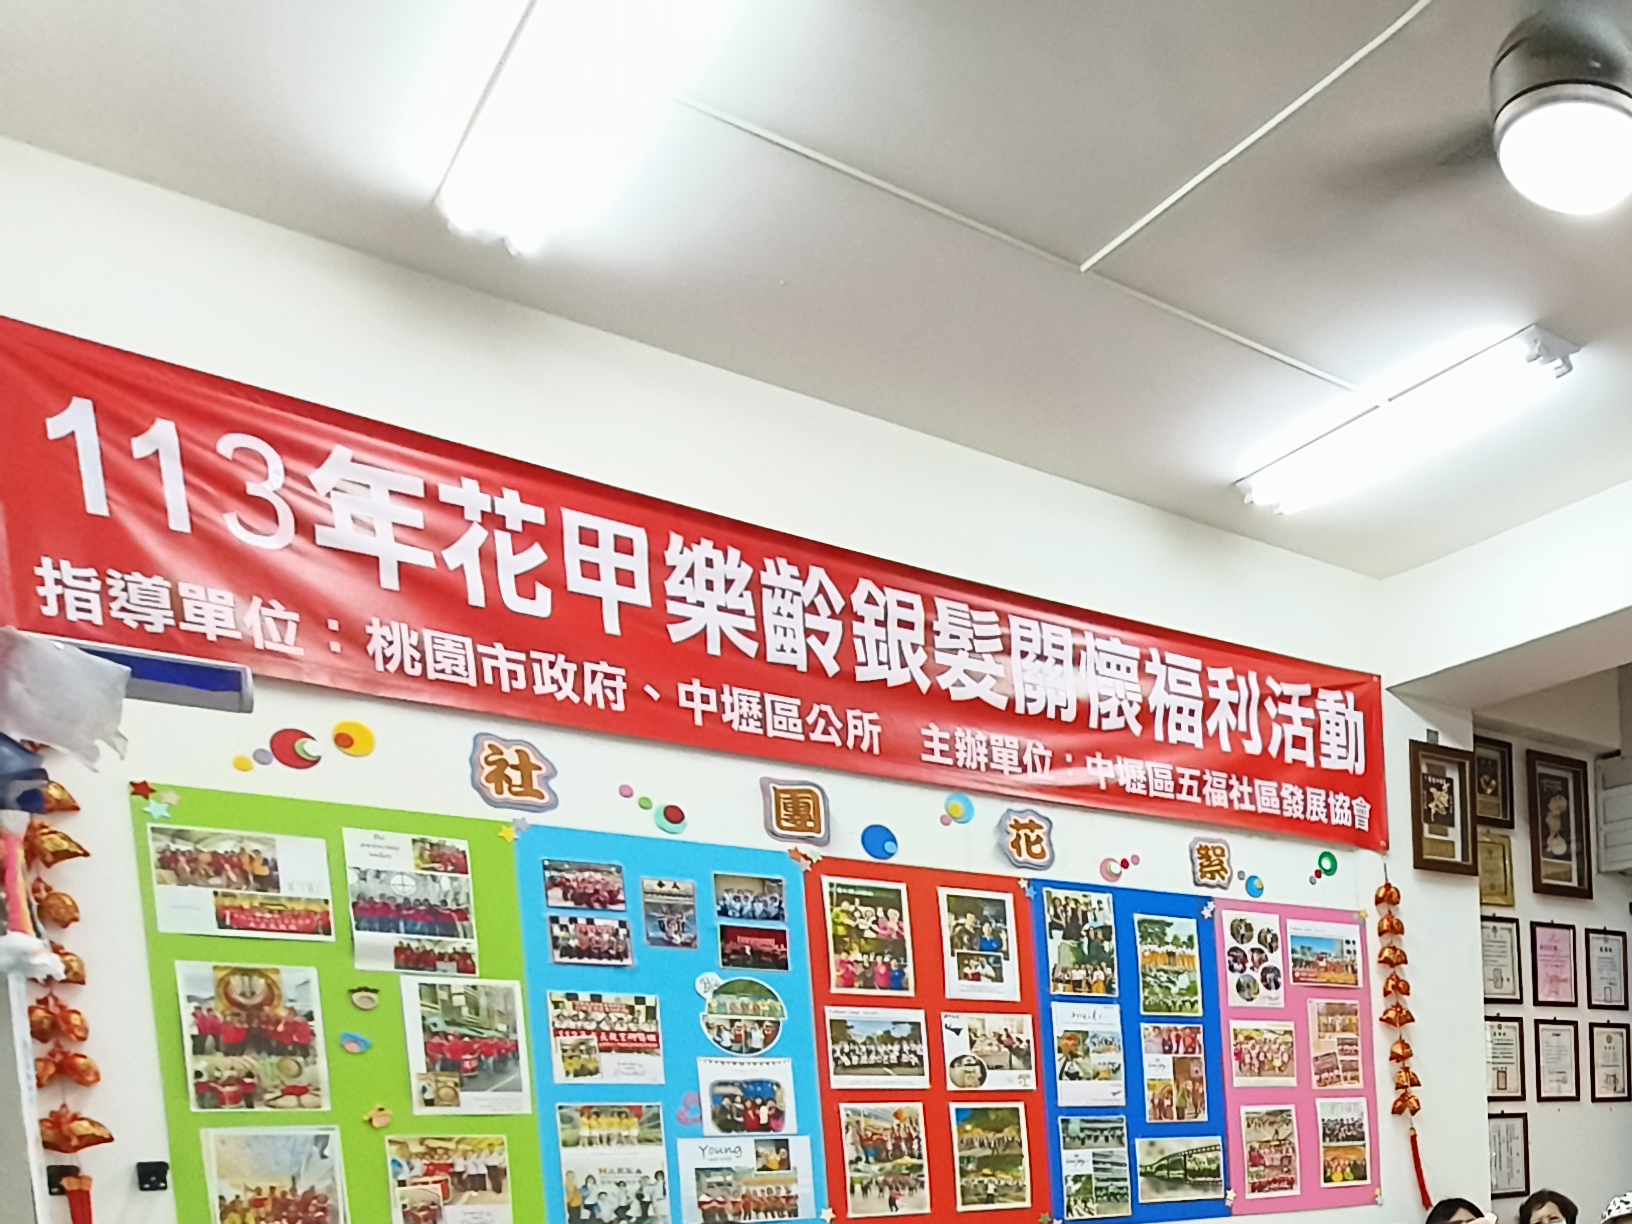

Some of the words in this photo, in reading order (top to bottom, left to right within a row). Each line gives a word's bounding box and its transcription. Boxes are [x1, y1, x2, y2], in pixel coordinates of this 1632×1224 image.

[45, 396, 1366, 775] 113年花甲樂齡銀髮關懷福利活動
[33, 556, 882, 756] 指導單位：桃園市政府、中壢區公所
[920, 722, 1372, 832] 主辦單位：中壢區五福社區發展協會
[484, 743, 545, 800] 社
[772, 786, 822, 834] 團
[1009, 818, 1046, 859] 花
[1196, 844, 1228, 880] 絮
[699, 1145, 742, 1158] Young
